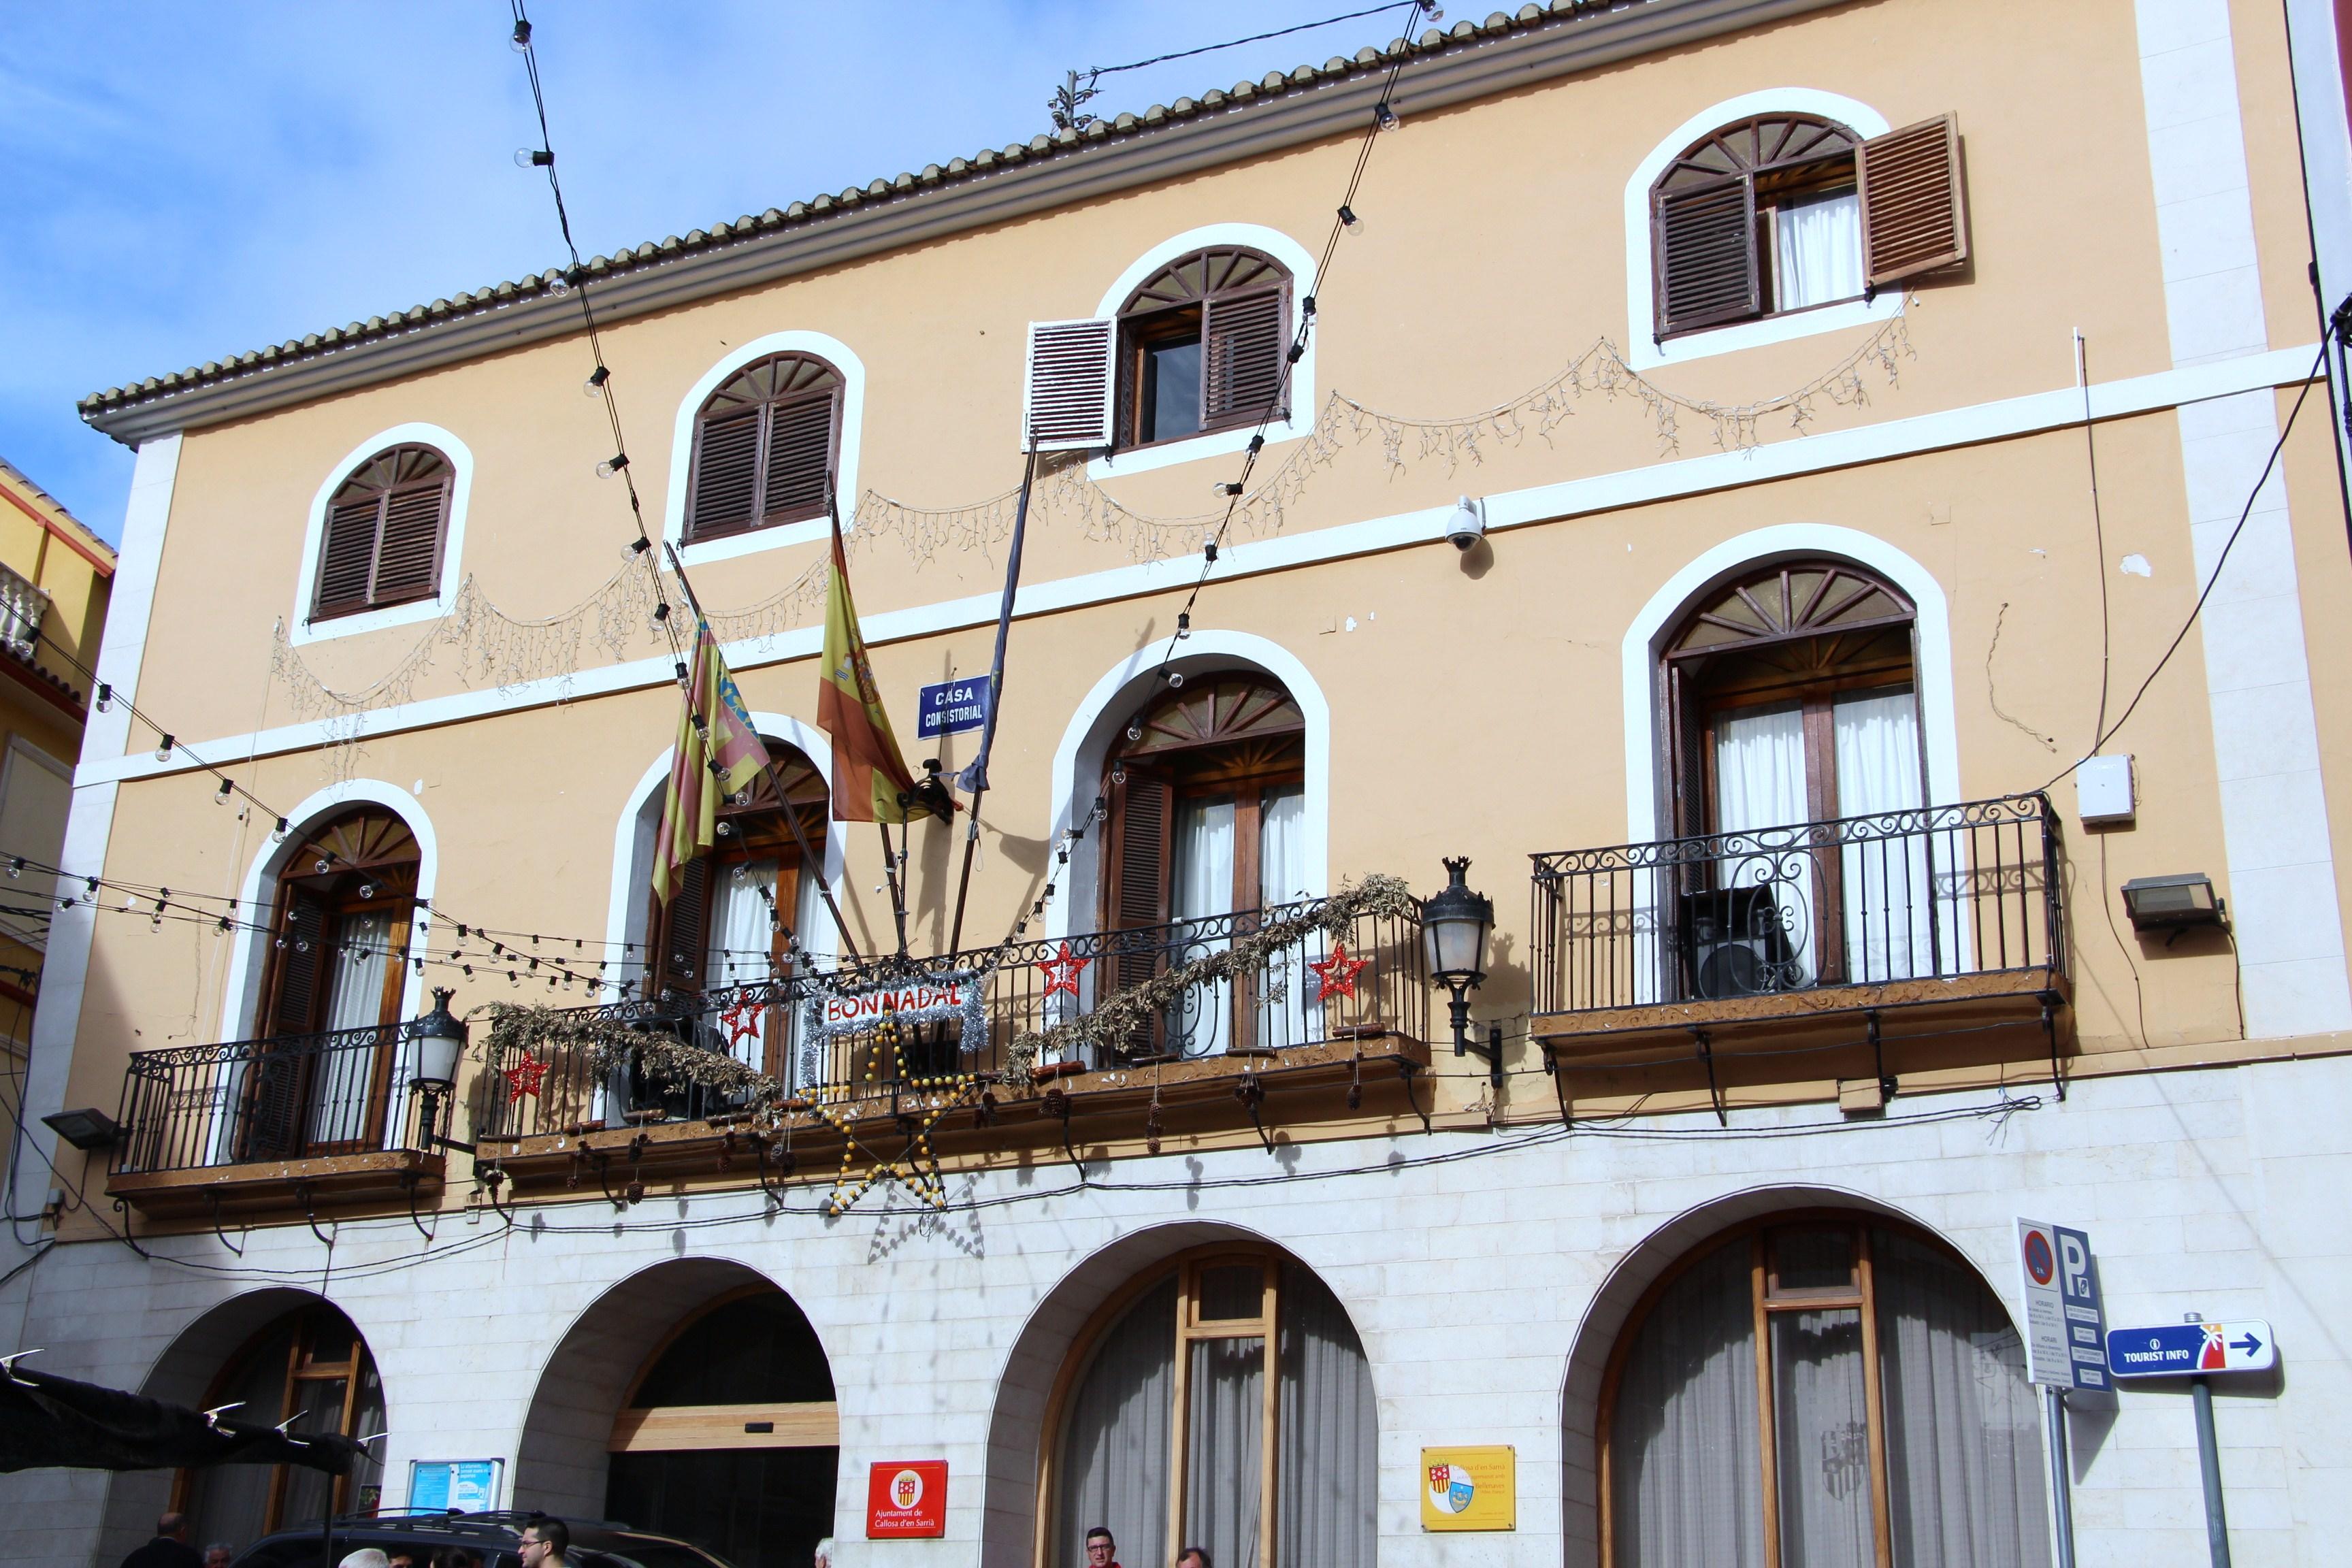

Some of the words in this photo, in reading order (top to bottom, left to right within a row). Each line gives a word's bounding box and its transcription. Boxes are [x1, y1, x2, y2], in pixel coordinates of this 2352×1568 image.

[935, 687, 974, 705] CASA
[926, 704, 982, 727] CONSISTORIAL
[828, 993, 878, 1021] BON
[883, 983, 962, 1013] NADAL
[2059, 1233, 2086, 1296] P
[2124, 1350, 2164, 1362] TOURIST
[2166, 1350, 2189, 1360] INFO
[875, 1509, 913, 1519] Ajuntament
[914, 1508, 923, 1516] de
[916, 1518, 934, 1526] Sarrià
